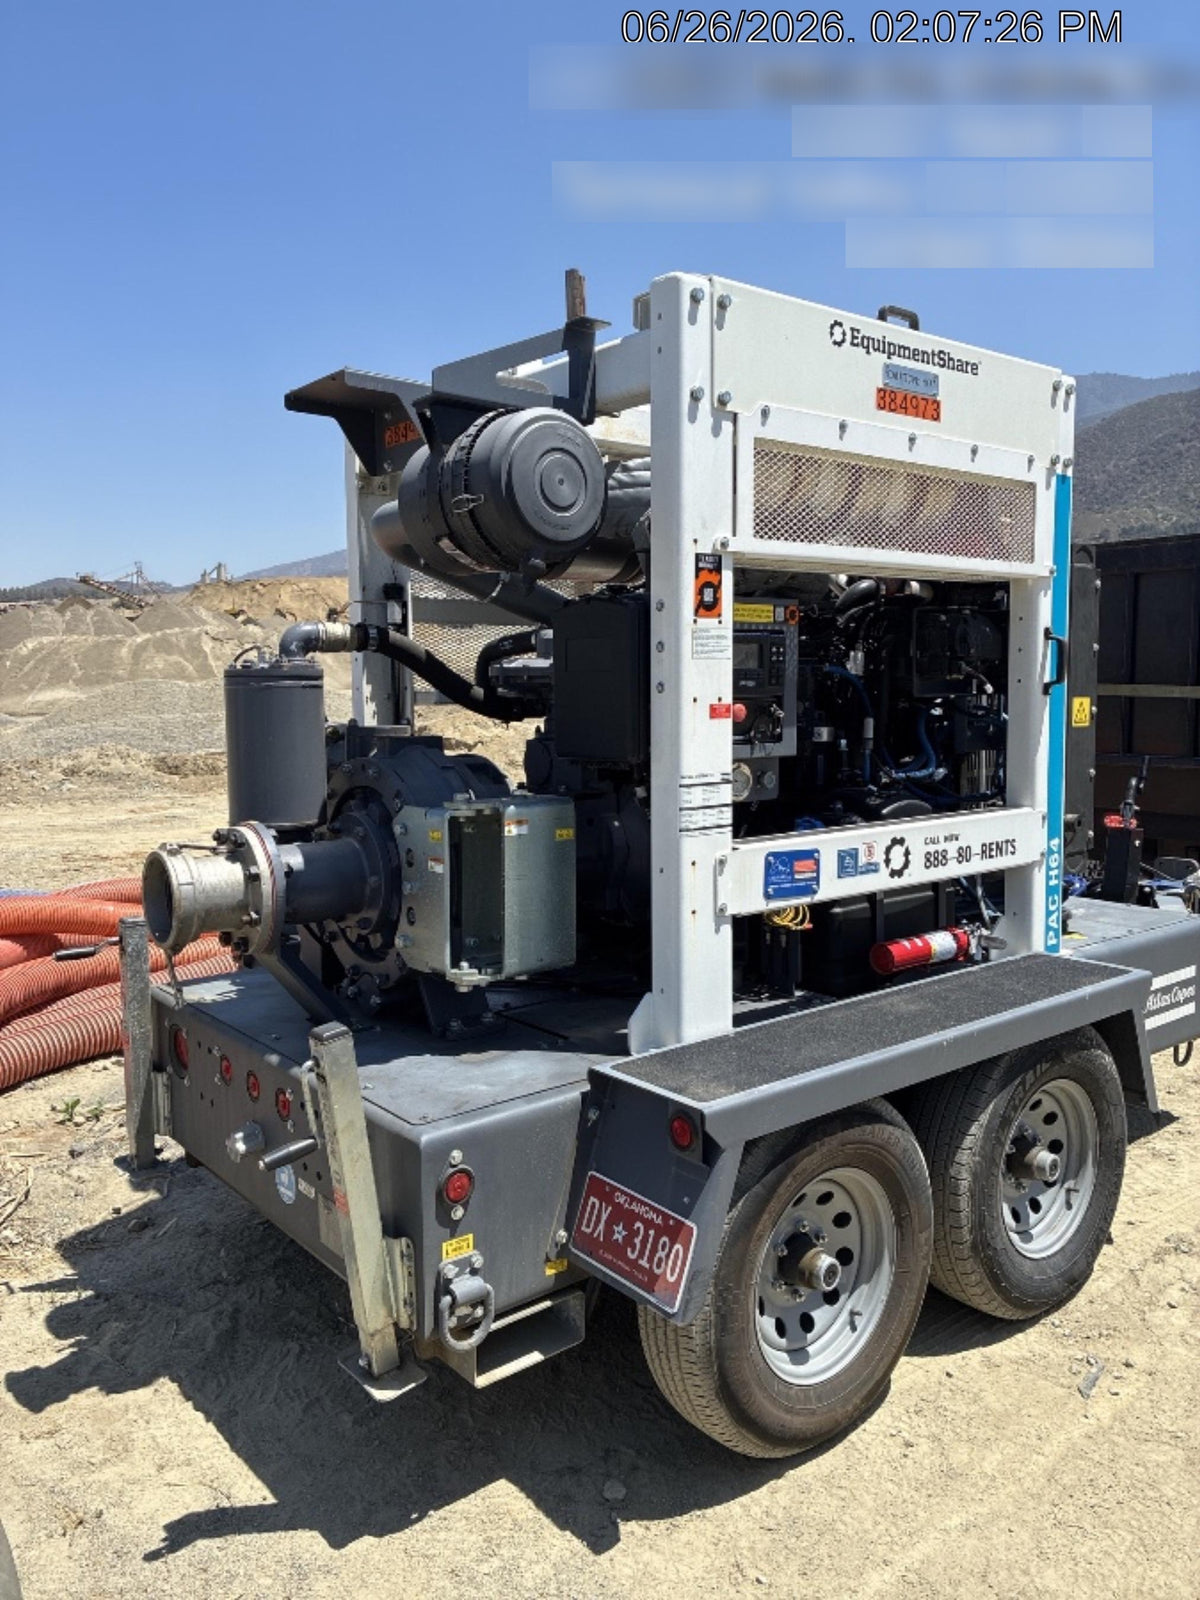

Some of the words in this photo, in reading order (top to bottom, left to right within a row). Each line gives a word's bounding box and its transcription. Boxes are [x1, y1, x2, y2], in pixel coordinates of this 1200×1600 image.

[849, 326, 980, 376] EquipmentShare
[877, 387, 940, 422] 384973
[924, 835, 941, 846] CALL
[924, 838, 1016, 870] 888-80-RENTS
[1049, 836, 1061, 886] H64
[1047, 893, 1059, 946] PAC
[614, 1191, 664, 1225] OKLAHOMA
[581, 1195, 612, 1242] DX
[627, 1221, 683, 1283] 3180
